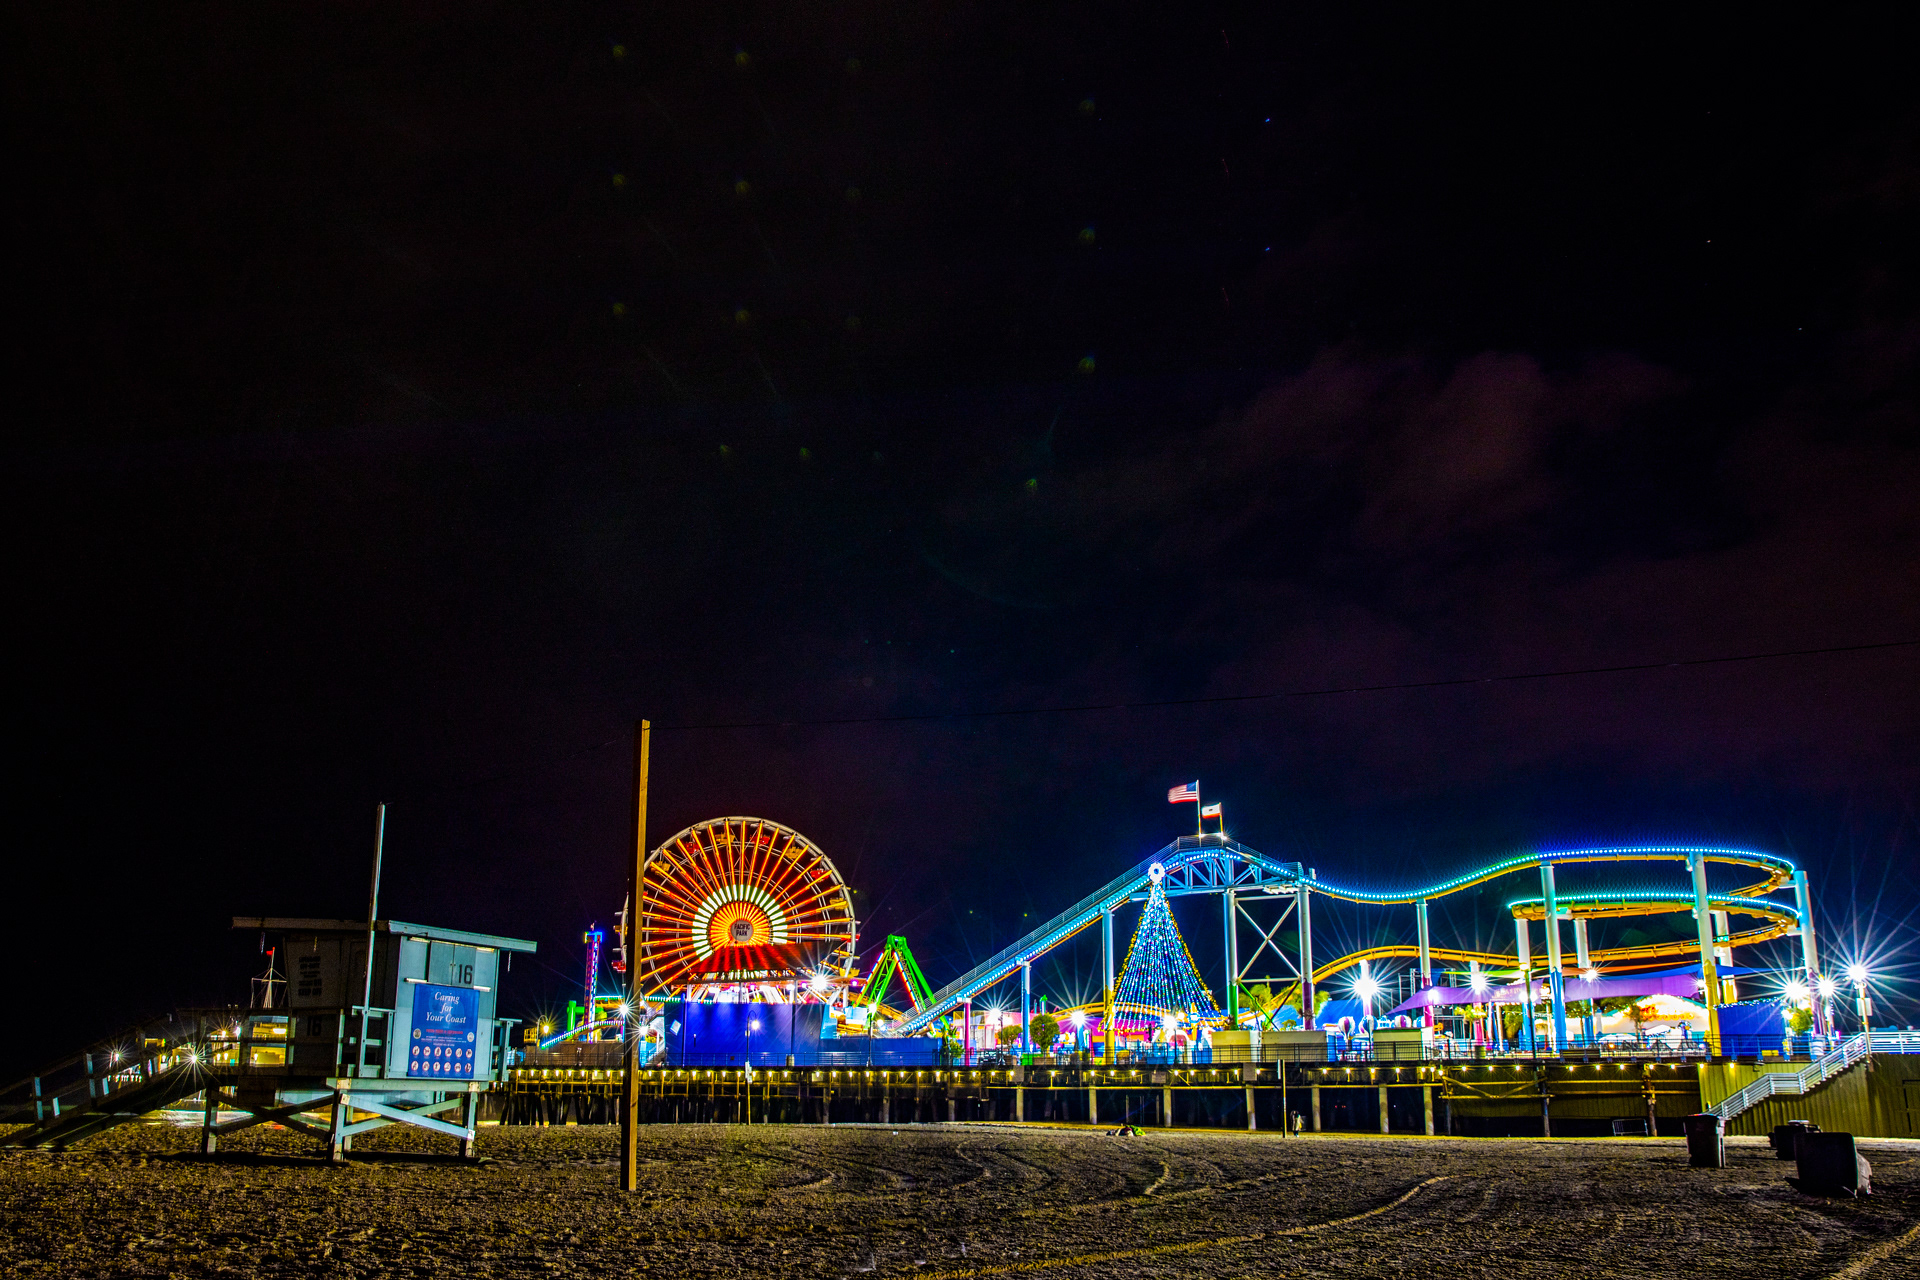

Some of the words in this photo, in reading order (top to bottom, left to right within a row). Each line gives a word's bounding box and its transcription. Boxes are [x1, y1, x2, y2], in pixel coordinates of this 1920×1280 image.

[458, 964, 473, 984] 16
[435, 991, 460, 1005] Caring
[439, 1003, 453, 1014] for
[426, 1012, 444, 1022] Your
[445, 1013, 467, 1024] Coast
[307, 1016, 322, 1036] 16
